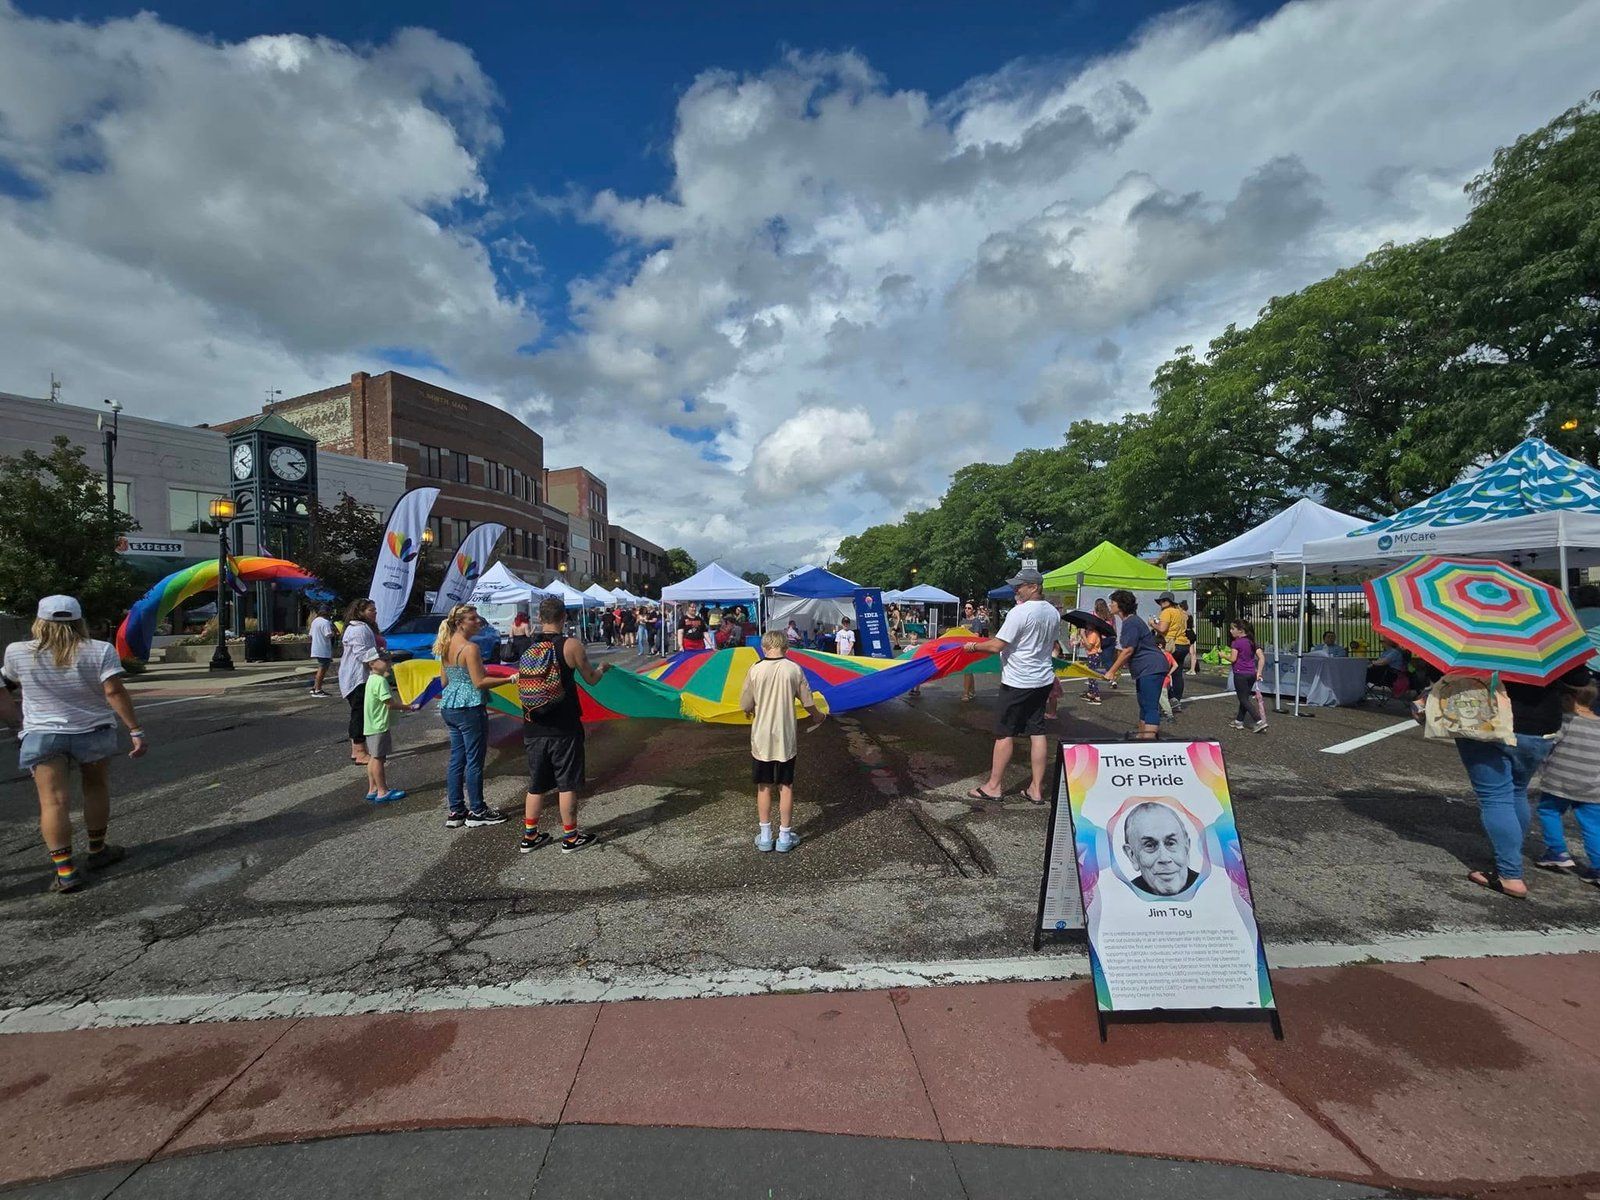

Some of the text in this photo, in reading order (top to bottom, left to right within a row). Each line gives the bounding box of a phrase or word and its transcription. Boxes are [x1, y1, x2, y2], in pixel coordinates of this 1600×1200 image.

[1394, 532, 1436, 544] MyCare
[132, 543, 179, 552] EXPRESS
[1100, 754, 1187, 769] The Spirit
[1111, 773, 1184, 787] Of Pride
[1148, 907, 1193, 918] Jim Toy
